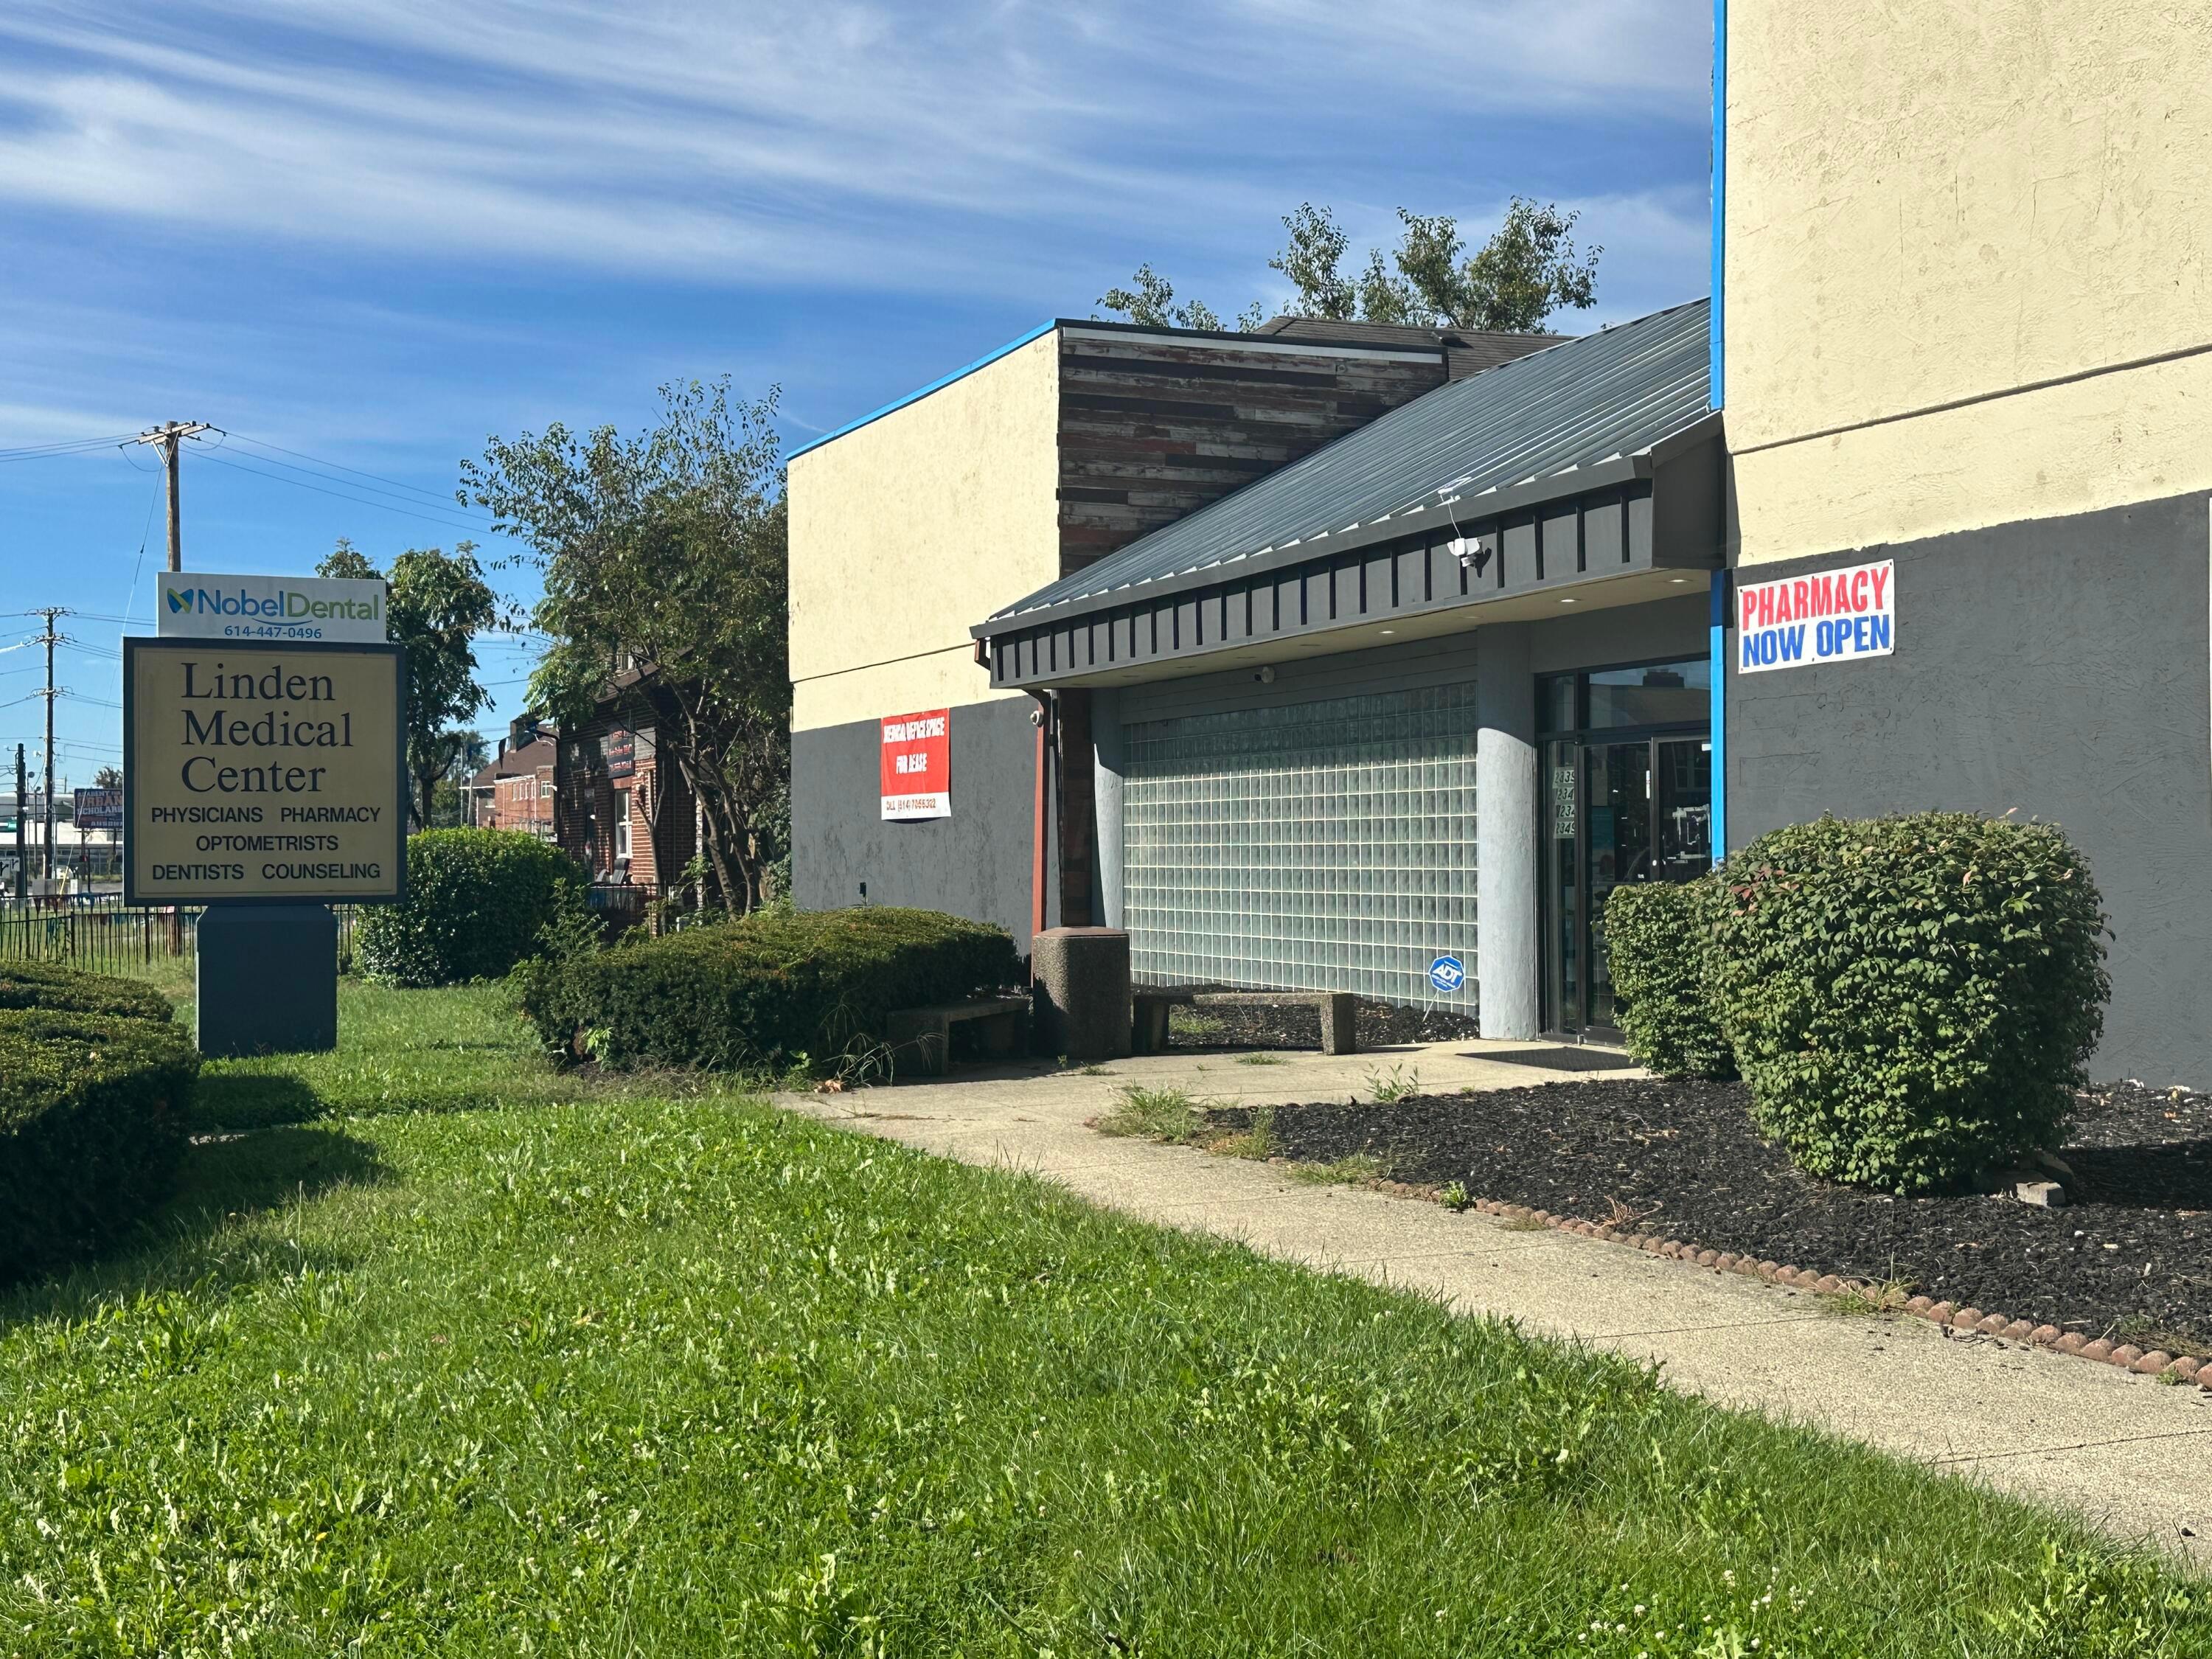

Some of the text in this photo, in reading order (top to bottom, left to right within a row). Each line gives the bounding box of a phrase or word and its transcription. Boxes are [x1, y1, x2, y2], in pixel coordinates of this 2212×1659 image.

[1742, 566, 1889, 630] PHARMACY
[225, 625, 322, 639] 614-447-0496
[1743, 614, 1890, 667] NOW OPEN
[181, 663, 336, 700] Linden
[181, 709, 354, 747] Medical
[908, 753, 928, 773] LEASE
[181, 757, 326, 792] Center
[151, 807, 381, 822] PHYSICIANS PHARMACY
[195, 835, 339, 851] OPTOMETRISTS
[152, 863, 381, 880] DENTISTS COUNSELING
[1433, 964, 1462, 983] ADT
